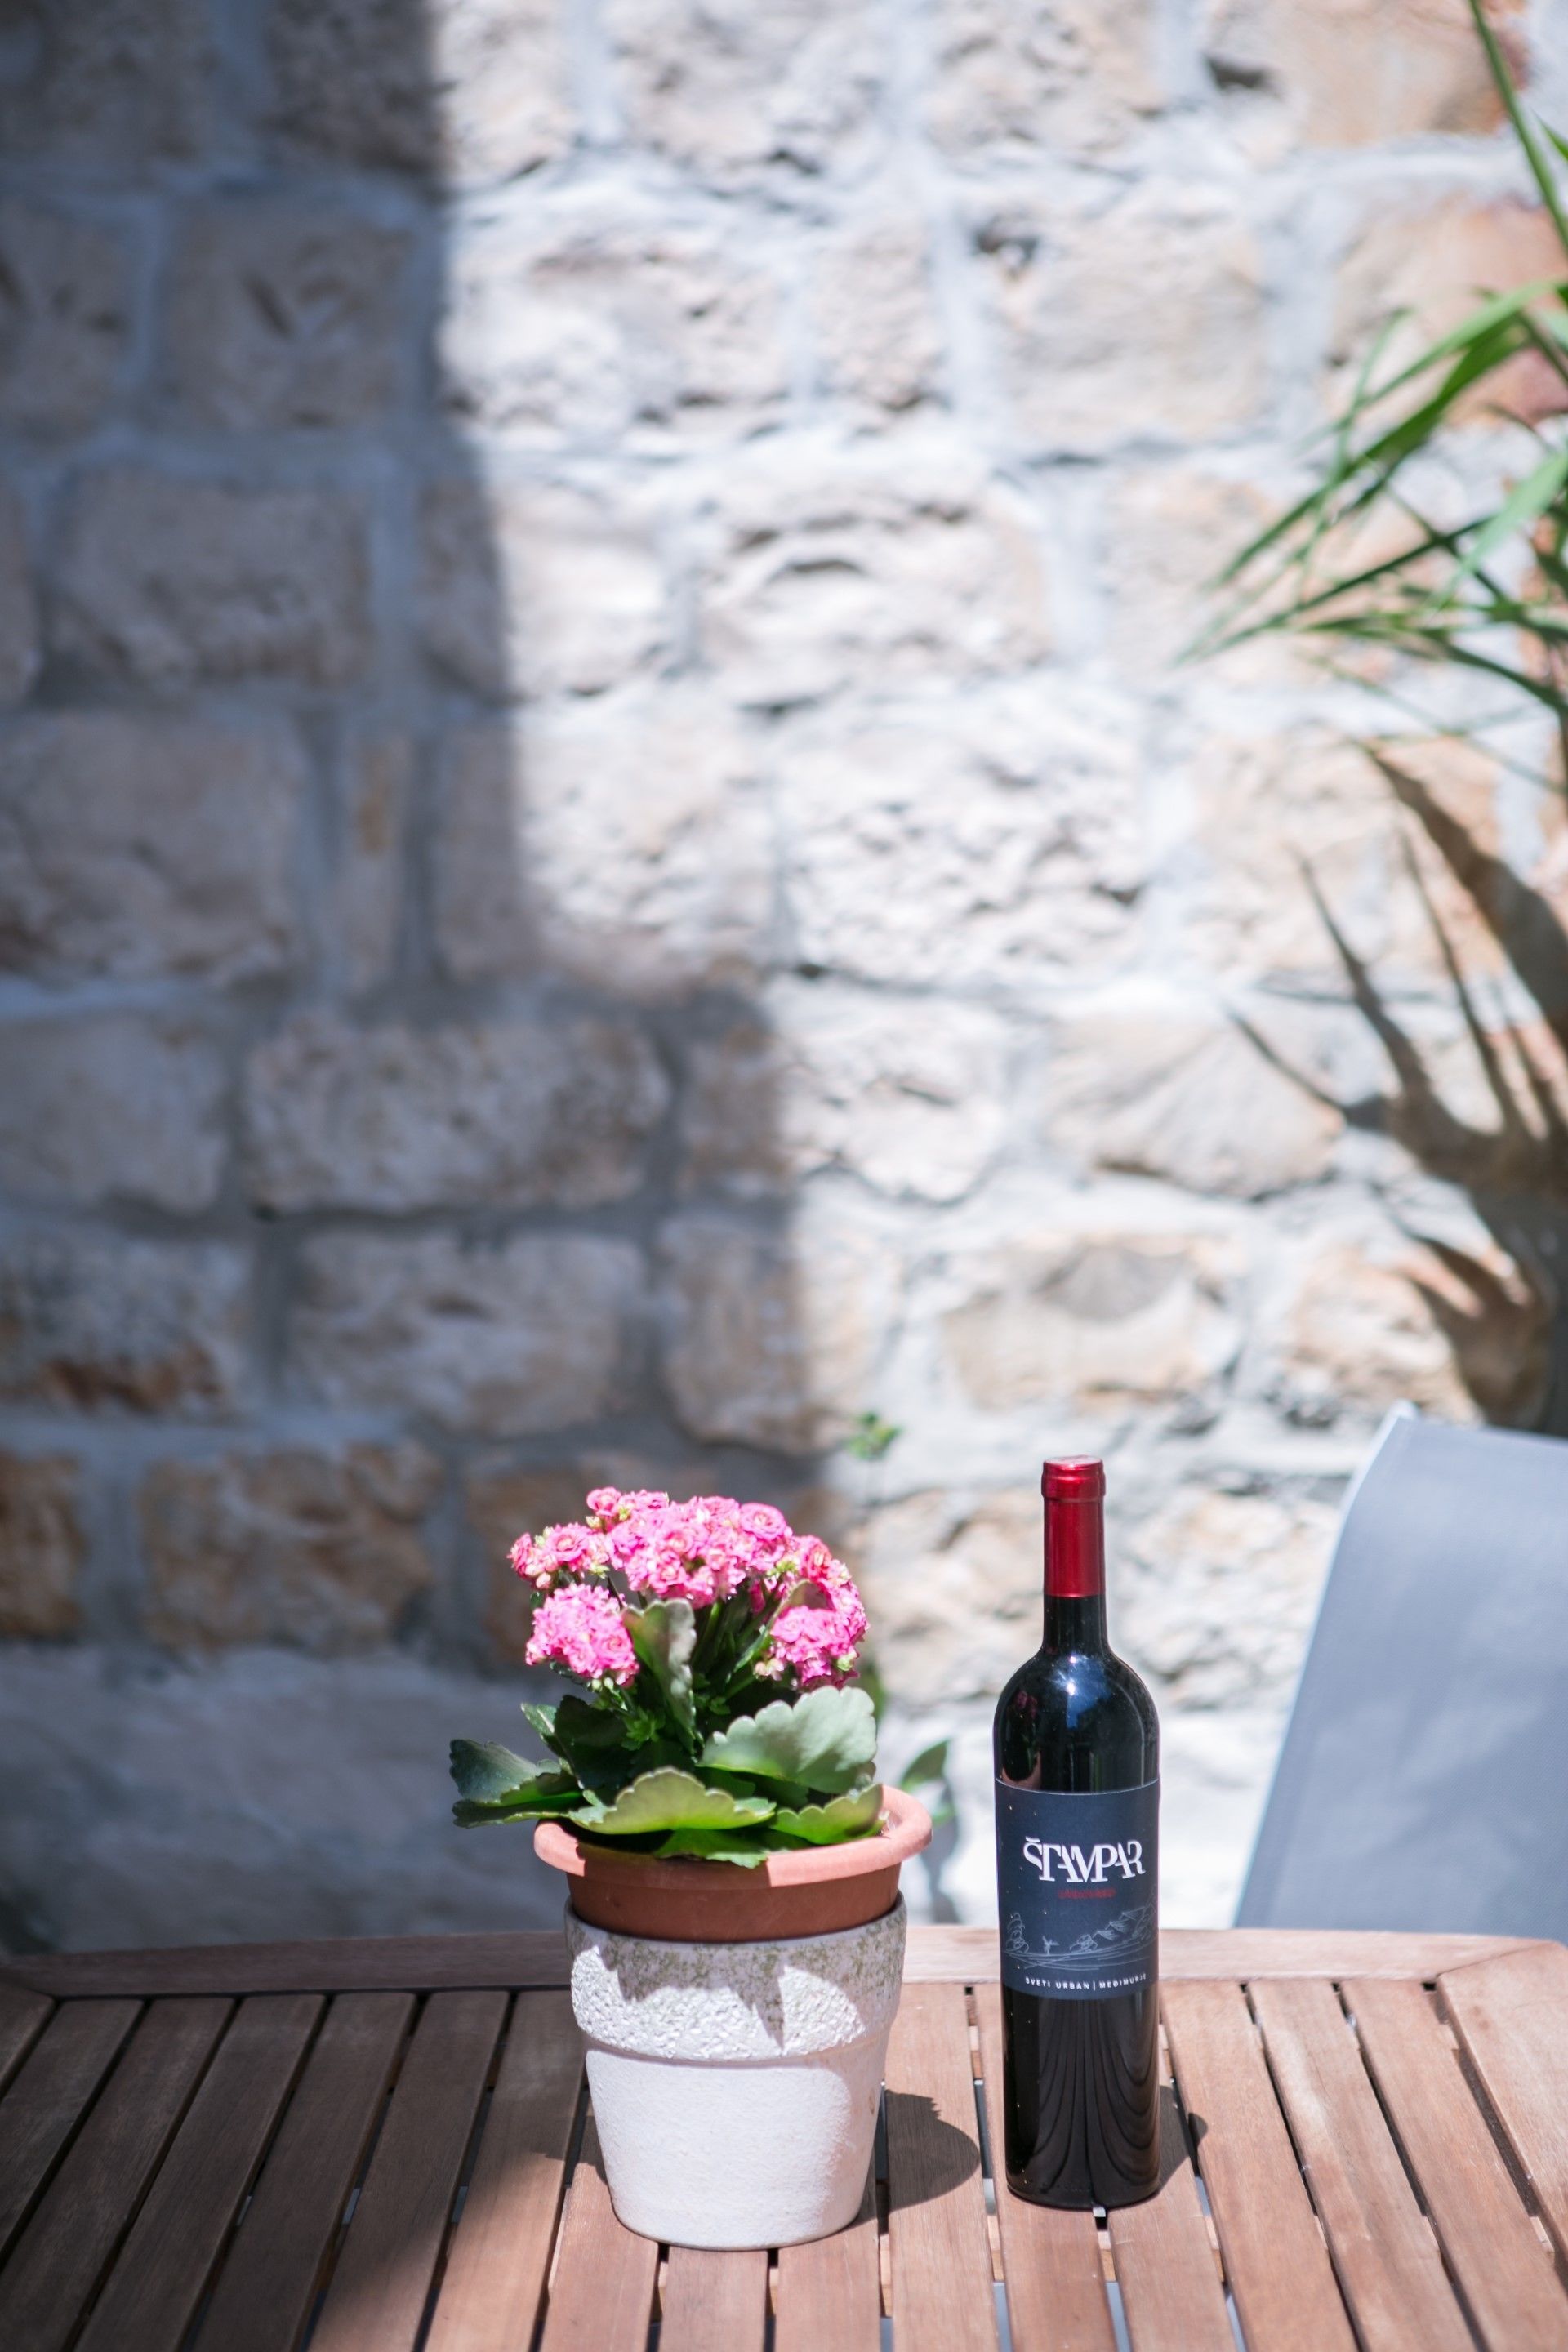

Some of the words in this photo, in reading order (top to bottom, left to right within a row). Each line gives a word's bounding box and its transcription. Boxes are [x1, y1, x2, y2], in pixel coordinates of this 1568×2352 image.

[1023, 1836, 1146, 1882] ŠTAMPAR
[1025, 1976, 1051, 1988] SVETI
[1056, 1982, 1089, 1990] URBAN
